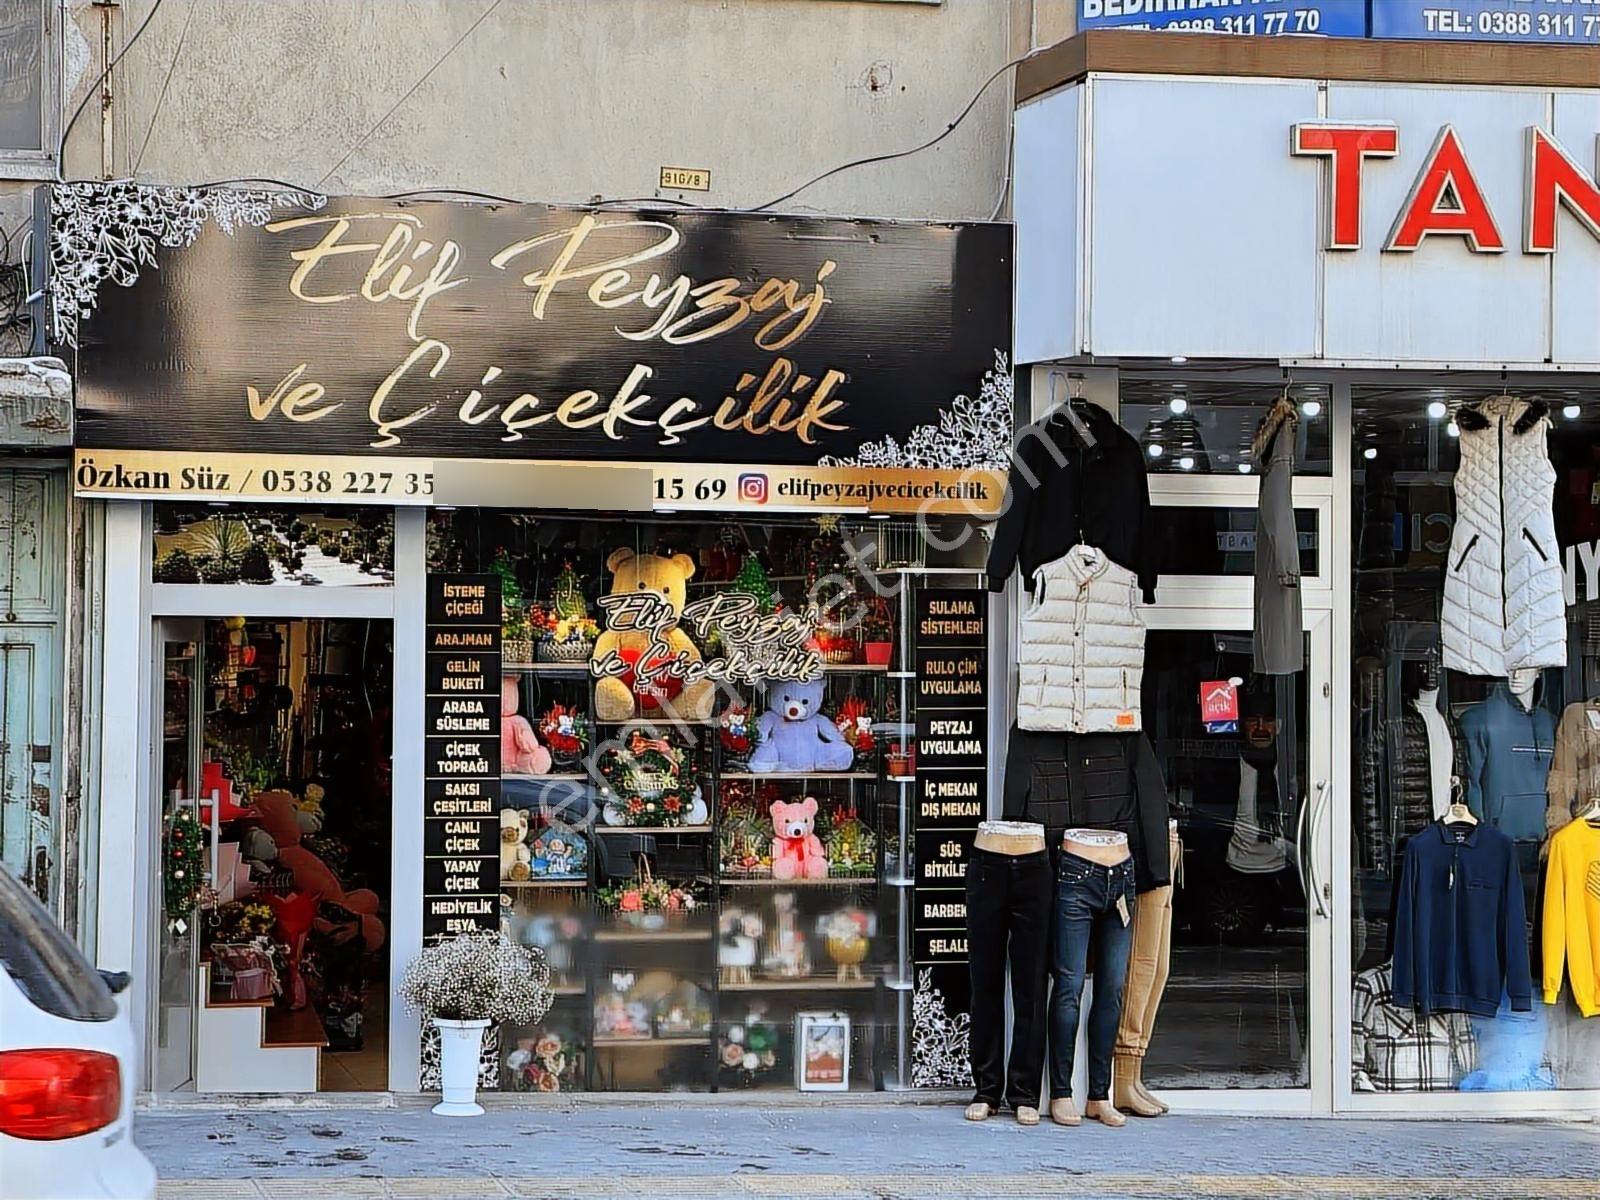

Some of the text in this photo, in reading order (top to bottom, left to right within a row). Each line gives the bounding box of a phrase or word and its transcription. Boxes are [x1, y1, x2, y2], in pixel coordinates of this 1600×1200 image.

[1222, 15, 1256, 35] 311
[1263, 11, 1289, 34] 77
[1294, 9, 1320, 32] 70
[1423, 9, 1473, 33] TEL:
[1479, 11, 1531, 35] 0388
[1538, 13, 1575, 37] 311
[266, 212, 838, 351] Elif Peyzaj
[247, 339, 856, 449] ve Çiçekçilik
[77, 458, 170, 490] Özkan
[181, 467, 231, 491] Süz
[262, 469, 332, 493] 0538
[342, 471, 394, 495] 227
[404, 472, 433, 496] 35
[654, 476, 684, 500] 15
[695, 477, 728, 501] 69
[777, 476, 989, 502] elifpeyzajvecicekcilik
[443, 582, 486, 598] İSTEME
[445, 600, 484, 616] ÇİÇEĞİ
[929, 601, 975, 615] SULAMA
[598, 591, 818, 646] Elif Peyzaj
[921, 617, 984, 635] SİSTEMLERİ
[435, 633, 492, 646] ARAJMAN
[446, 658, 480, 673] GELİN
[590, 642, 825, 686] ve Çiçekçilik
[926, 657, 978, 677] RULO ÇİM
[442, 675, 484, 690] BUKETİ
[920, 680, 982, 695] UYGULAMA
[442, 701, 484, 714] ARABA
[436, 717, 490, 731] SÜSLEME
[930, 720, 973, 735] PEYZAJ
[445, 740, 480, 757] ÇİÇEK
[920, 740, 982, 755] UYGULAMA
[437, 758, 489, 773] TOPRAĞI
[445, 783, 480, 796] SAKSI
[925, 779, 978, 799] İÇ MEKAN
[433, 798, 492, 815] ÇEŞİTLERİ
[921, 802, 981, 819] DIŞ MEKAN
[445, 821, 480, 834] CANLI
[445, 836, 480, 854] ÇİÇEK
[939, 841, 962, 858] SÜS
[443, 860, 481, 873] YAPAY
[924, 860, 968, 878] BİTKİLE
[445, 875, 480, 892] ÇİÇEK
[431, 899, 493, 915] HEDİYELİK
[446, 919, 477, 934] EŞYA
